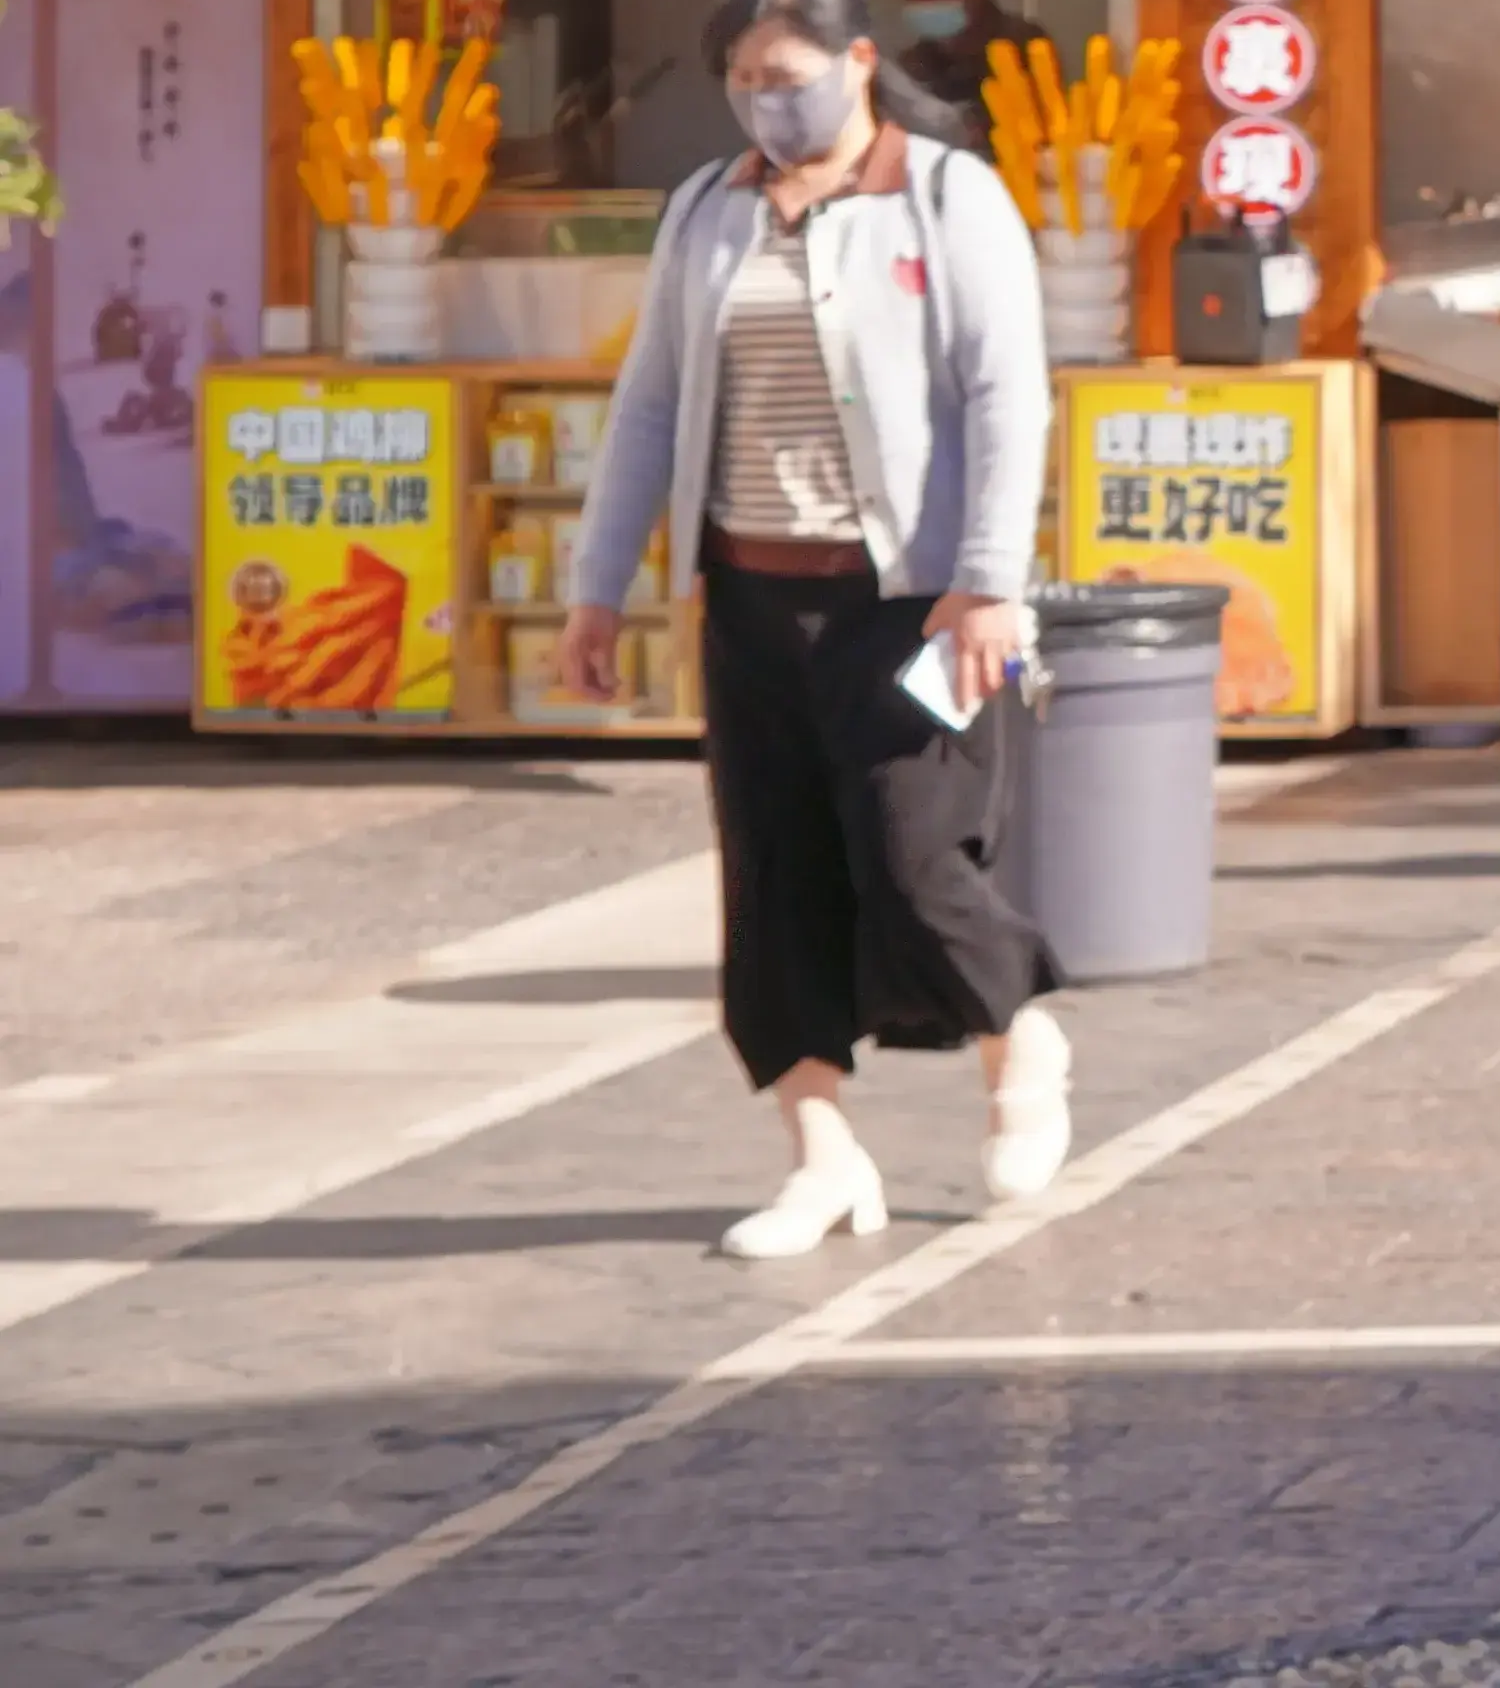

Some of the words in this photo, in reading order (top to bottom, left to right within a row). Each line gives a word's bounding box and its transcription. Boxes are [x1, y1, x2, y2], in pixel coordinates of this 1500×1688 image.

[228, 473, 430, 526] 领导品牌
[1098, 476, 1289, 541] 更好吃
